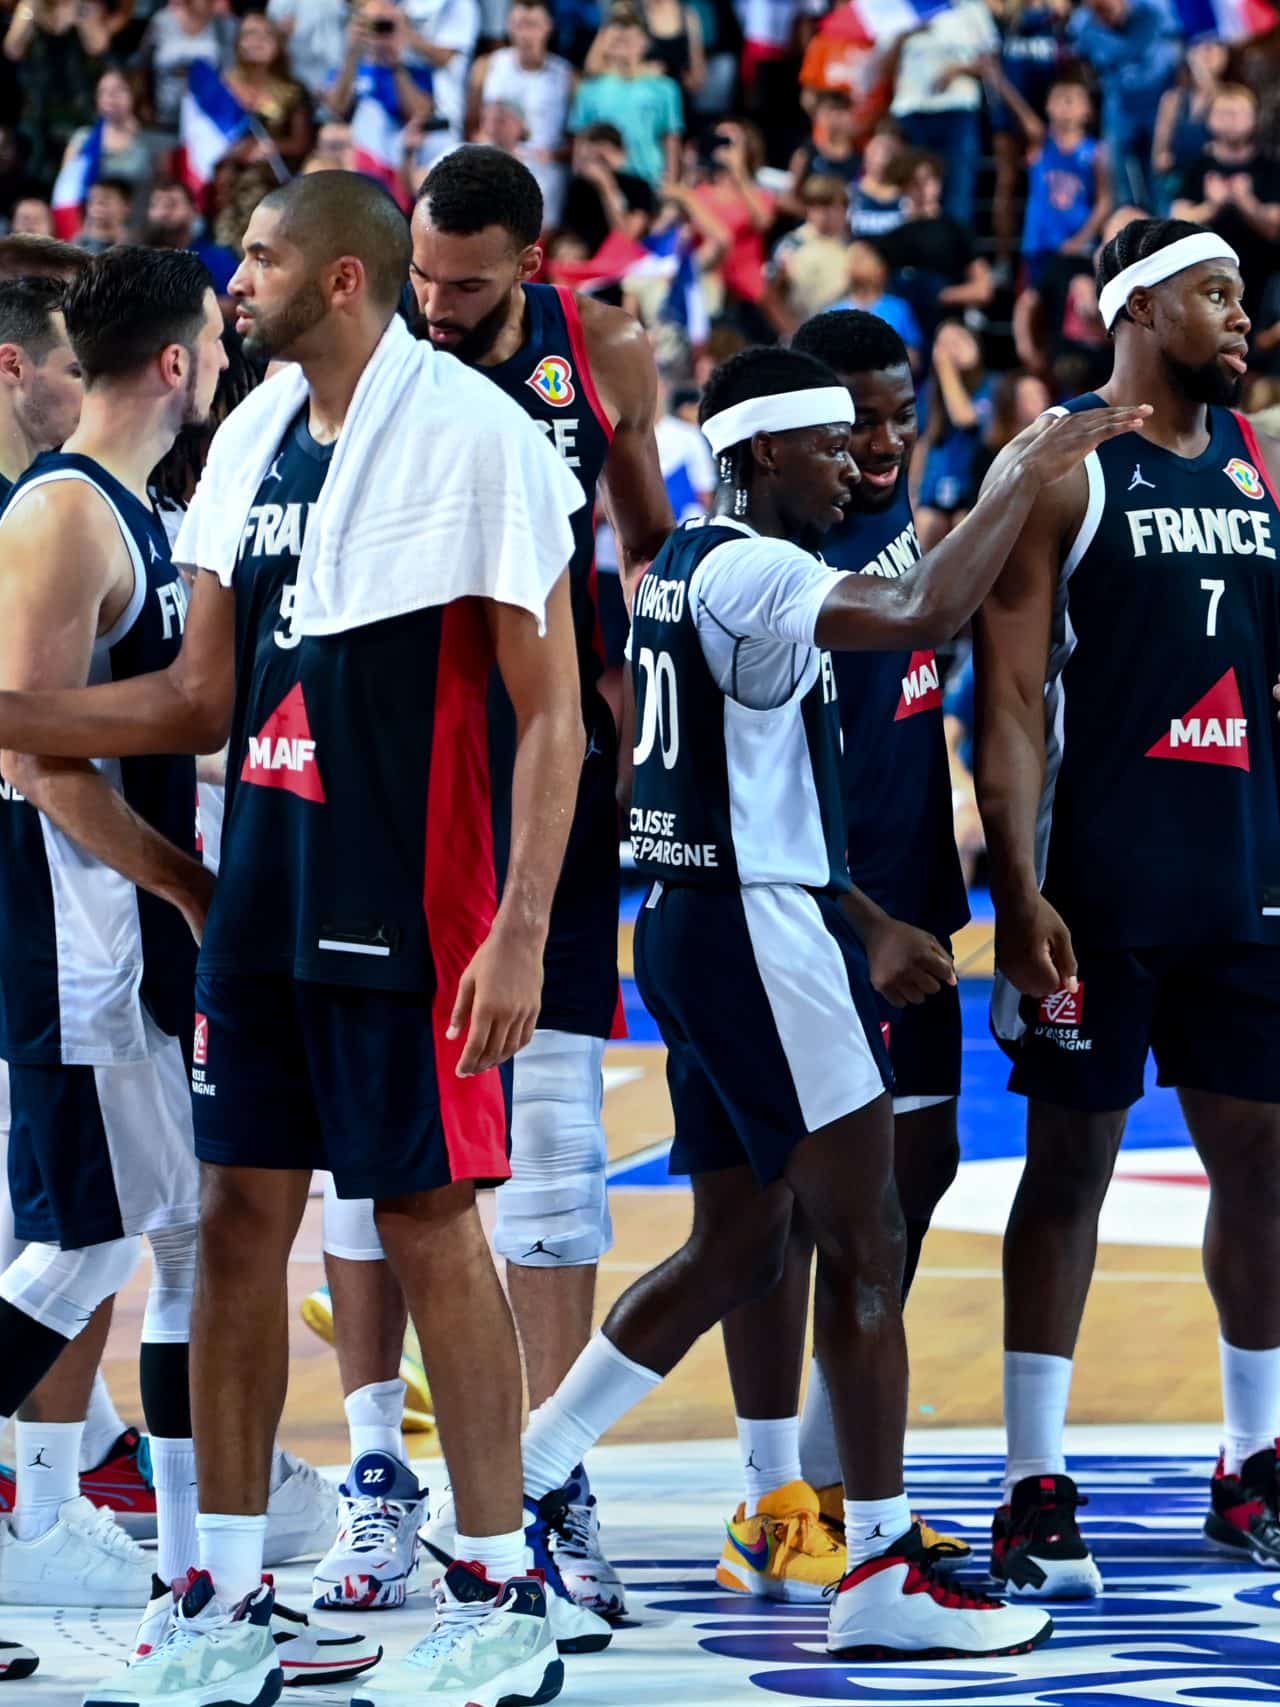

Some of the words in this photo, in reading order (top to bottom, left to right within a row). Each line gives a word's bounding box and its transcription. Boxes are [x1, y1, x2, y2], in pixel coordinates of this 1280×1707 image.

[1124, 507, 1277, 560] FRANCE
[1200, 578, 1225, 637] 7
[902, 659, 940, 706] MAI
[248, 735, 317, 773] MAIF
[1169, 717, 1248, 748] MAIF
